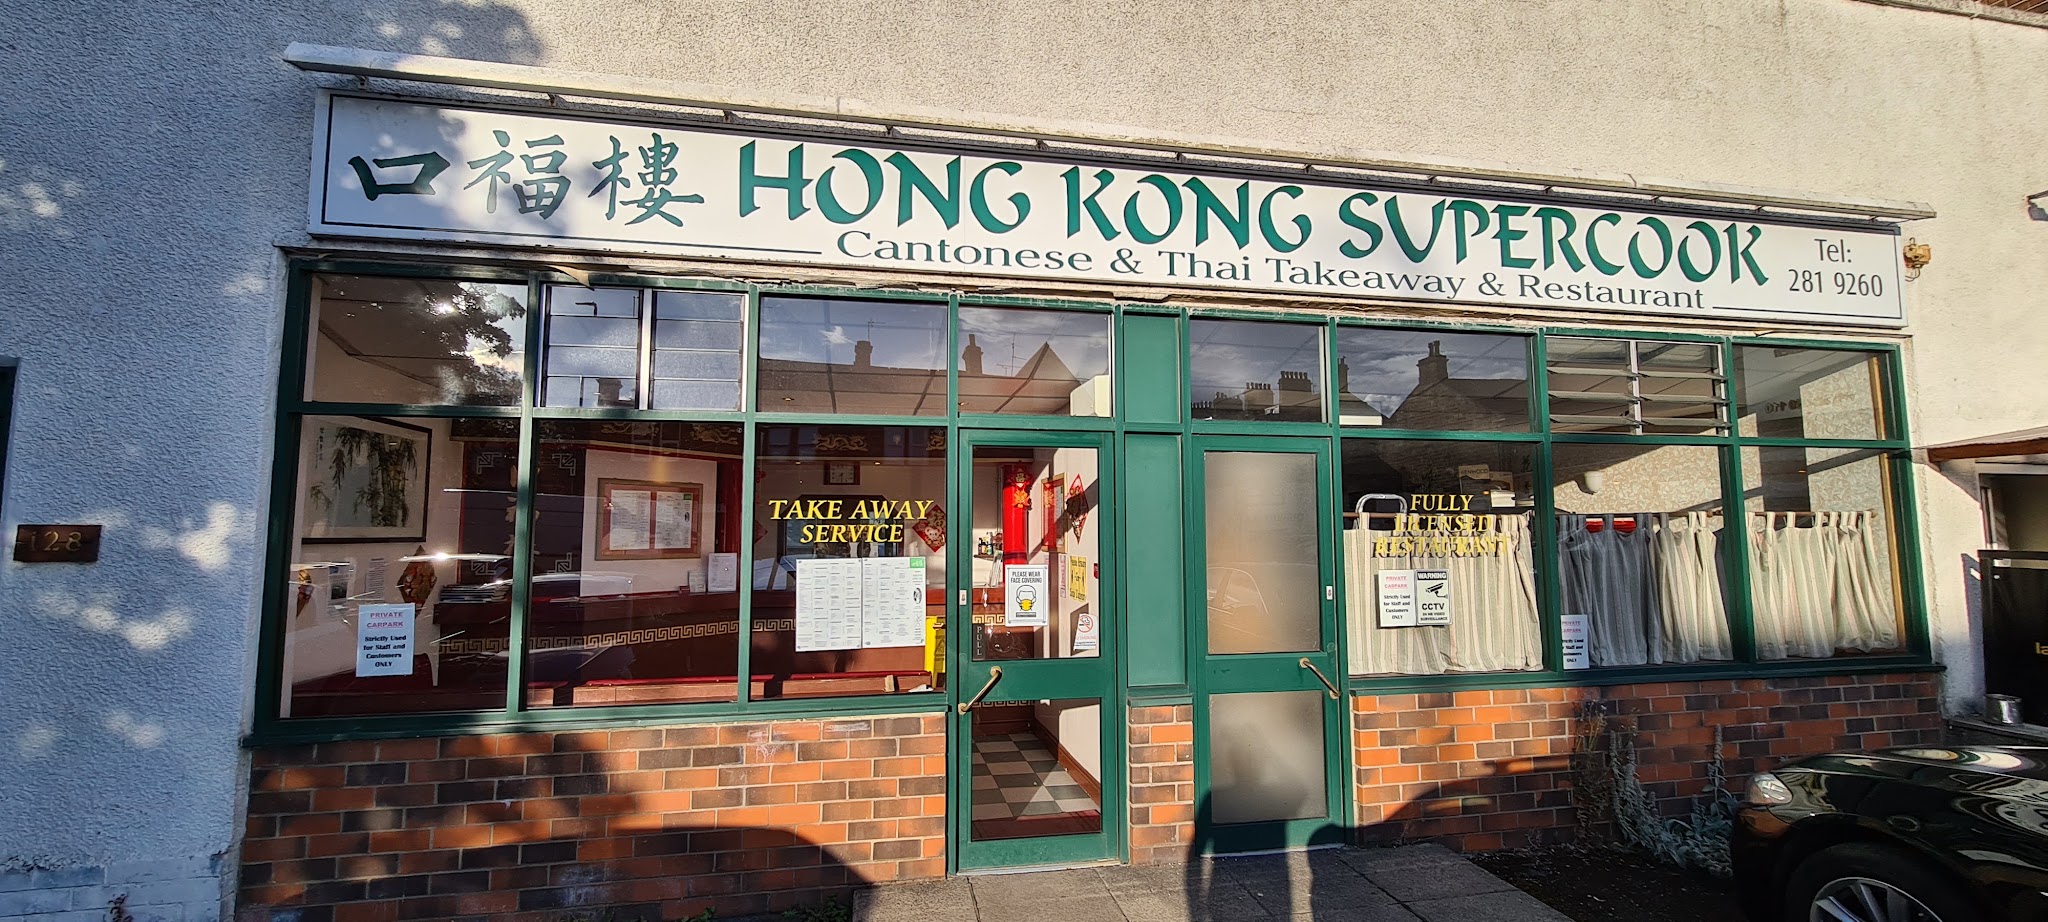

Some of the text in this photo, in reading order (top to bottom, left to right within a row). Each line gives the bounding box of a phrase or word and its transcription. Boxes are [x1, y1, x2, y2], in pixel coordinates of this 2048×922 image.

[348, 129, 705, 229] 口福樓
[739, 139, 1769, 286] HONG KONG SUPERCOOK
[1813, 238, 1852, 263] Tel:
[837, 230, 1705, 310] Cantonese & Thai Takeaway & Restaurant
[1788, 268, 1883, 297] 281 9260
[768, 499, 935, 520] TAKE AWAY
[1410, 493, 1475, 512] FULLY
[1394, 514, 1493, 533] LICENSED
[31, 530, 82, 552] 128
[800, 524, 904, 544] SERVICE
[1375, 536, 1508, 555] RESTAURANT
[1417, 572, 1447, 580] WARNING
[370, 611, 404, 619] PRIVATE
[1421, 602, 1445, 611] CCTV
[366, 621, 404, 629] CARPARK
[364, 635, 388, 643] Strictly
